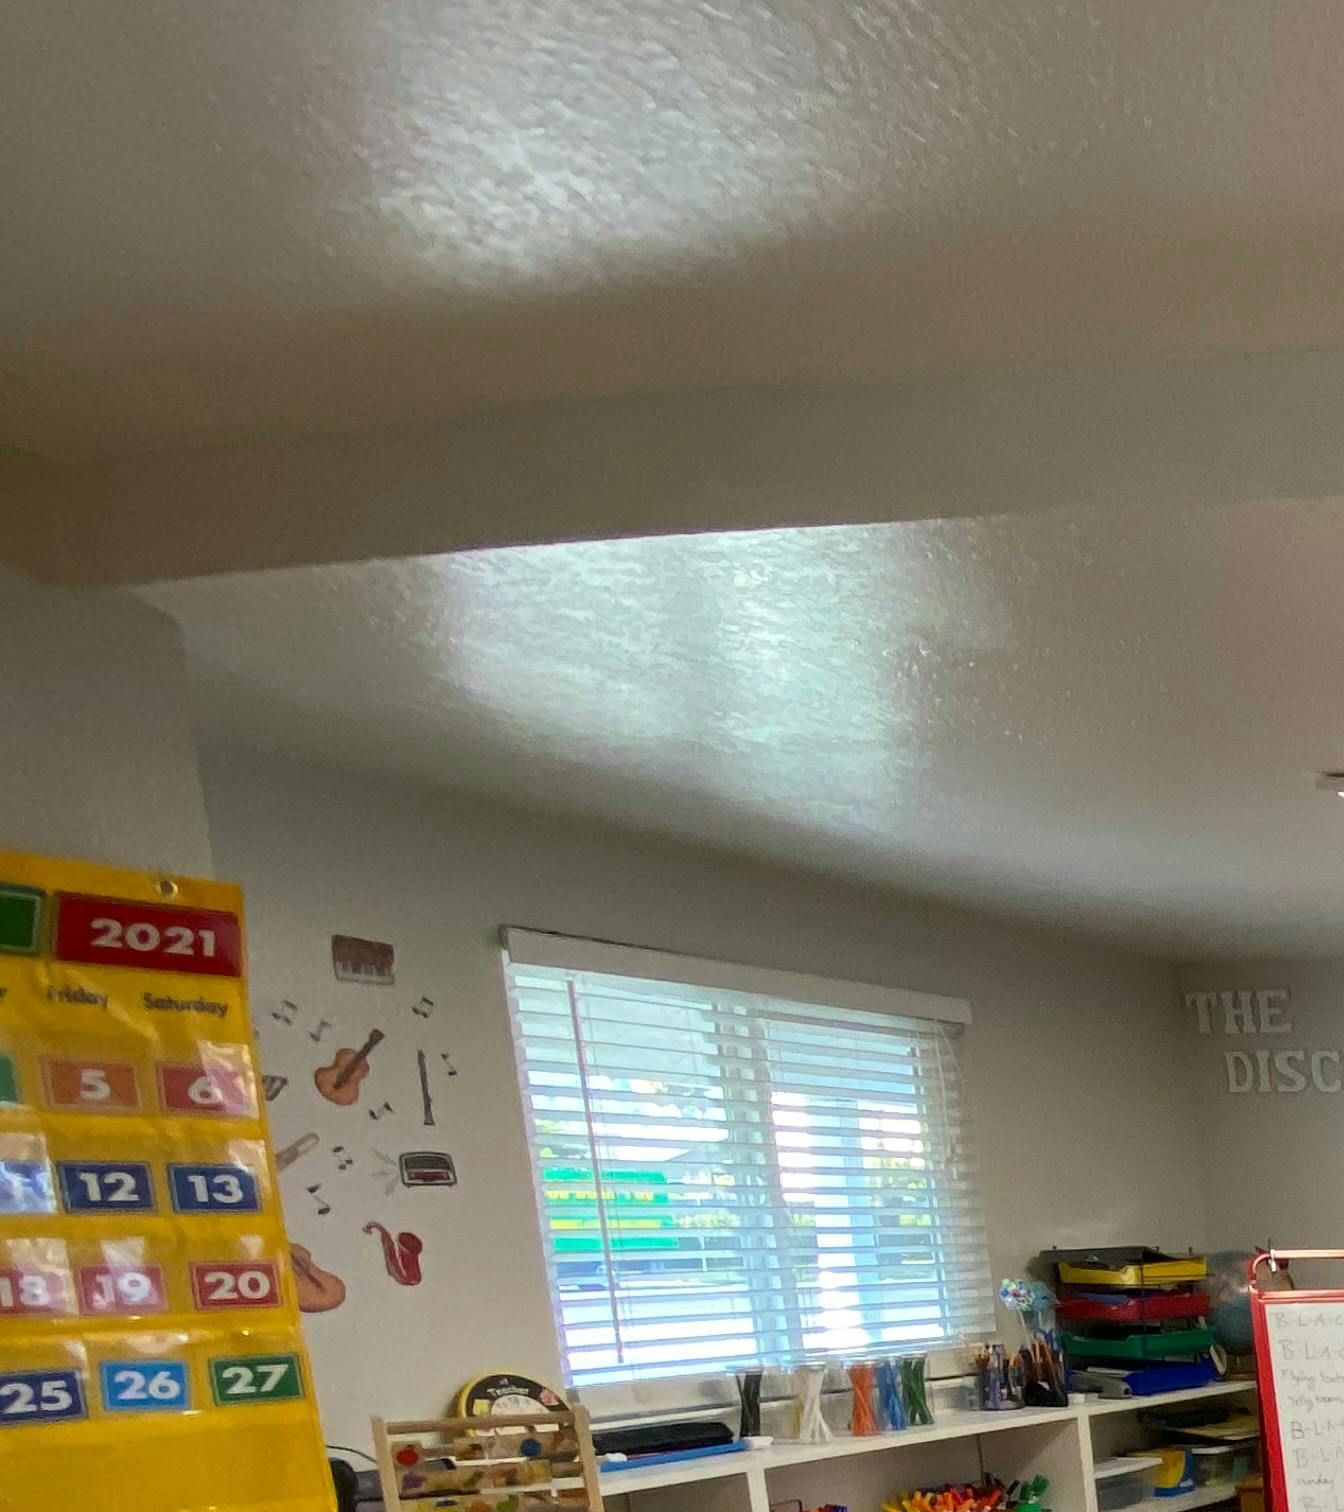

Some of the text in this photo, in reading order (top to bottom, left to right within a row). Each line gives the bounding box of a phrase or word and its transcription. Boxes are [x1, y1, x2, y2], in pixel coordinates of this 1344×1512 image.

[90, 917, 216, 957] 2021
[48, 985, 228, 1018] Friday Saturday
[1184, 988, 1293, 1034] THE
[80, 1068, 223, 1104] 5 6
[79, 1171, 139, 1203] 12
[188, 1174, 243, 1204] 13
[92, 1272, 150, 1305] 19
[204, 1270, 270, 1300] 20
[0, 1364, 289, 1413] 25 26 27
